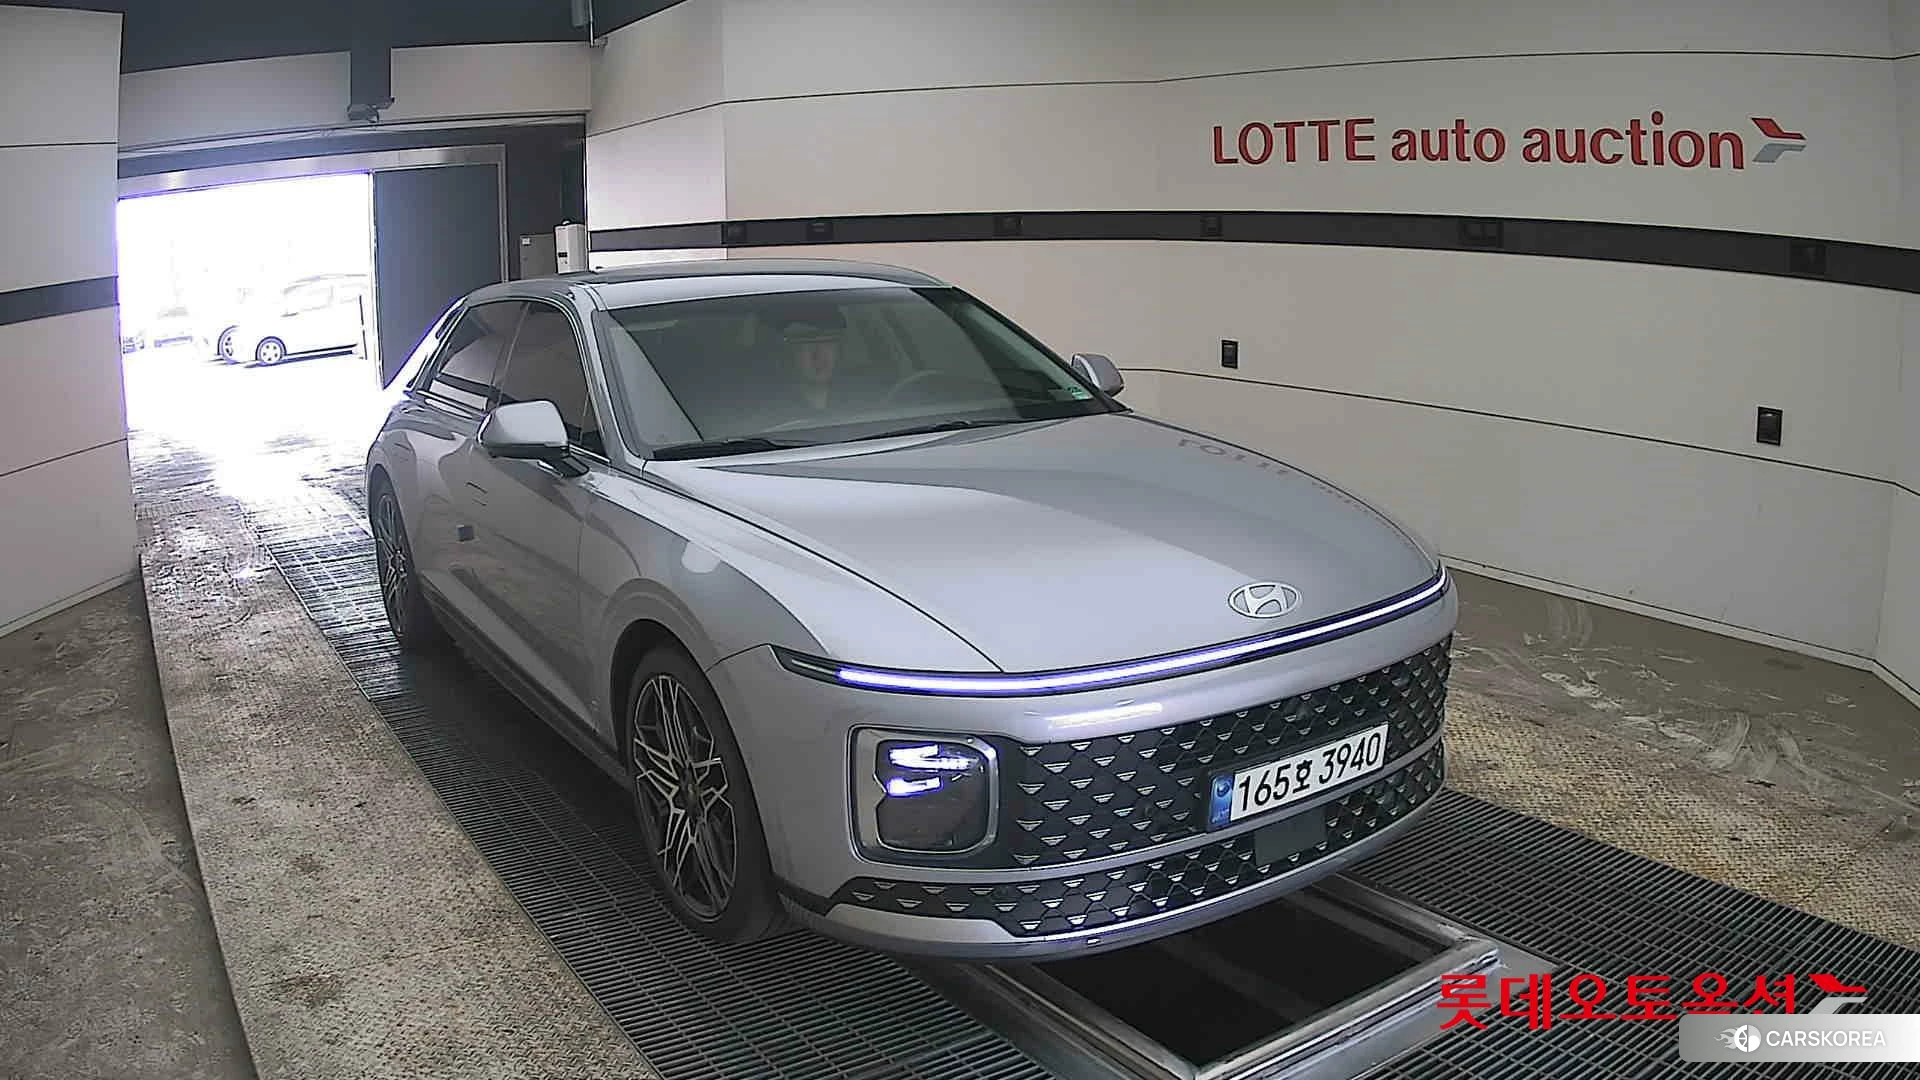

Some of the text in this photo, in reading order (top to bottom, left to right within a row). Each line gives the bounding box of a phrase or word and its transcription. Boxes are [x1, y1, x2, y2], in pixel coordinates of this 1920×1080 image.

[1212, 110, 1746, 170] LOTTE auto auction
[1238, 732, 1382, 812] 165호 3940
